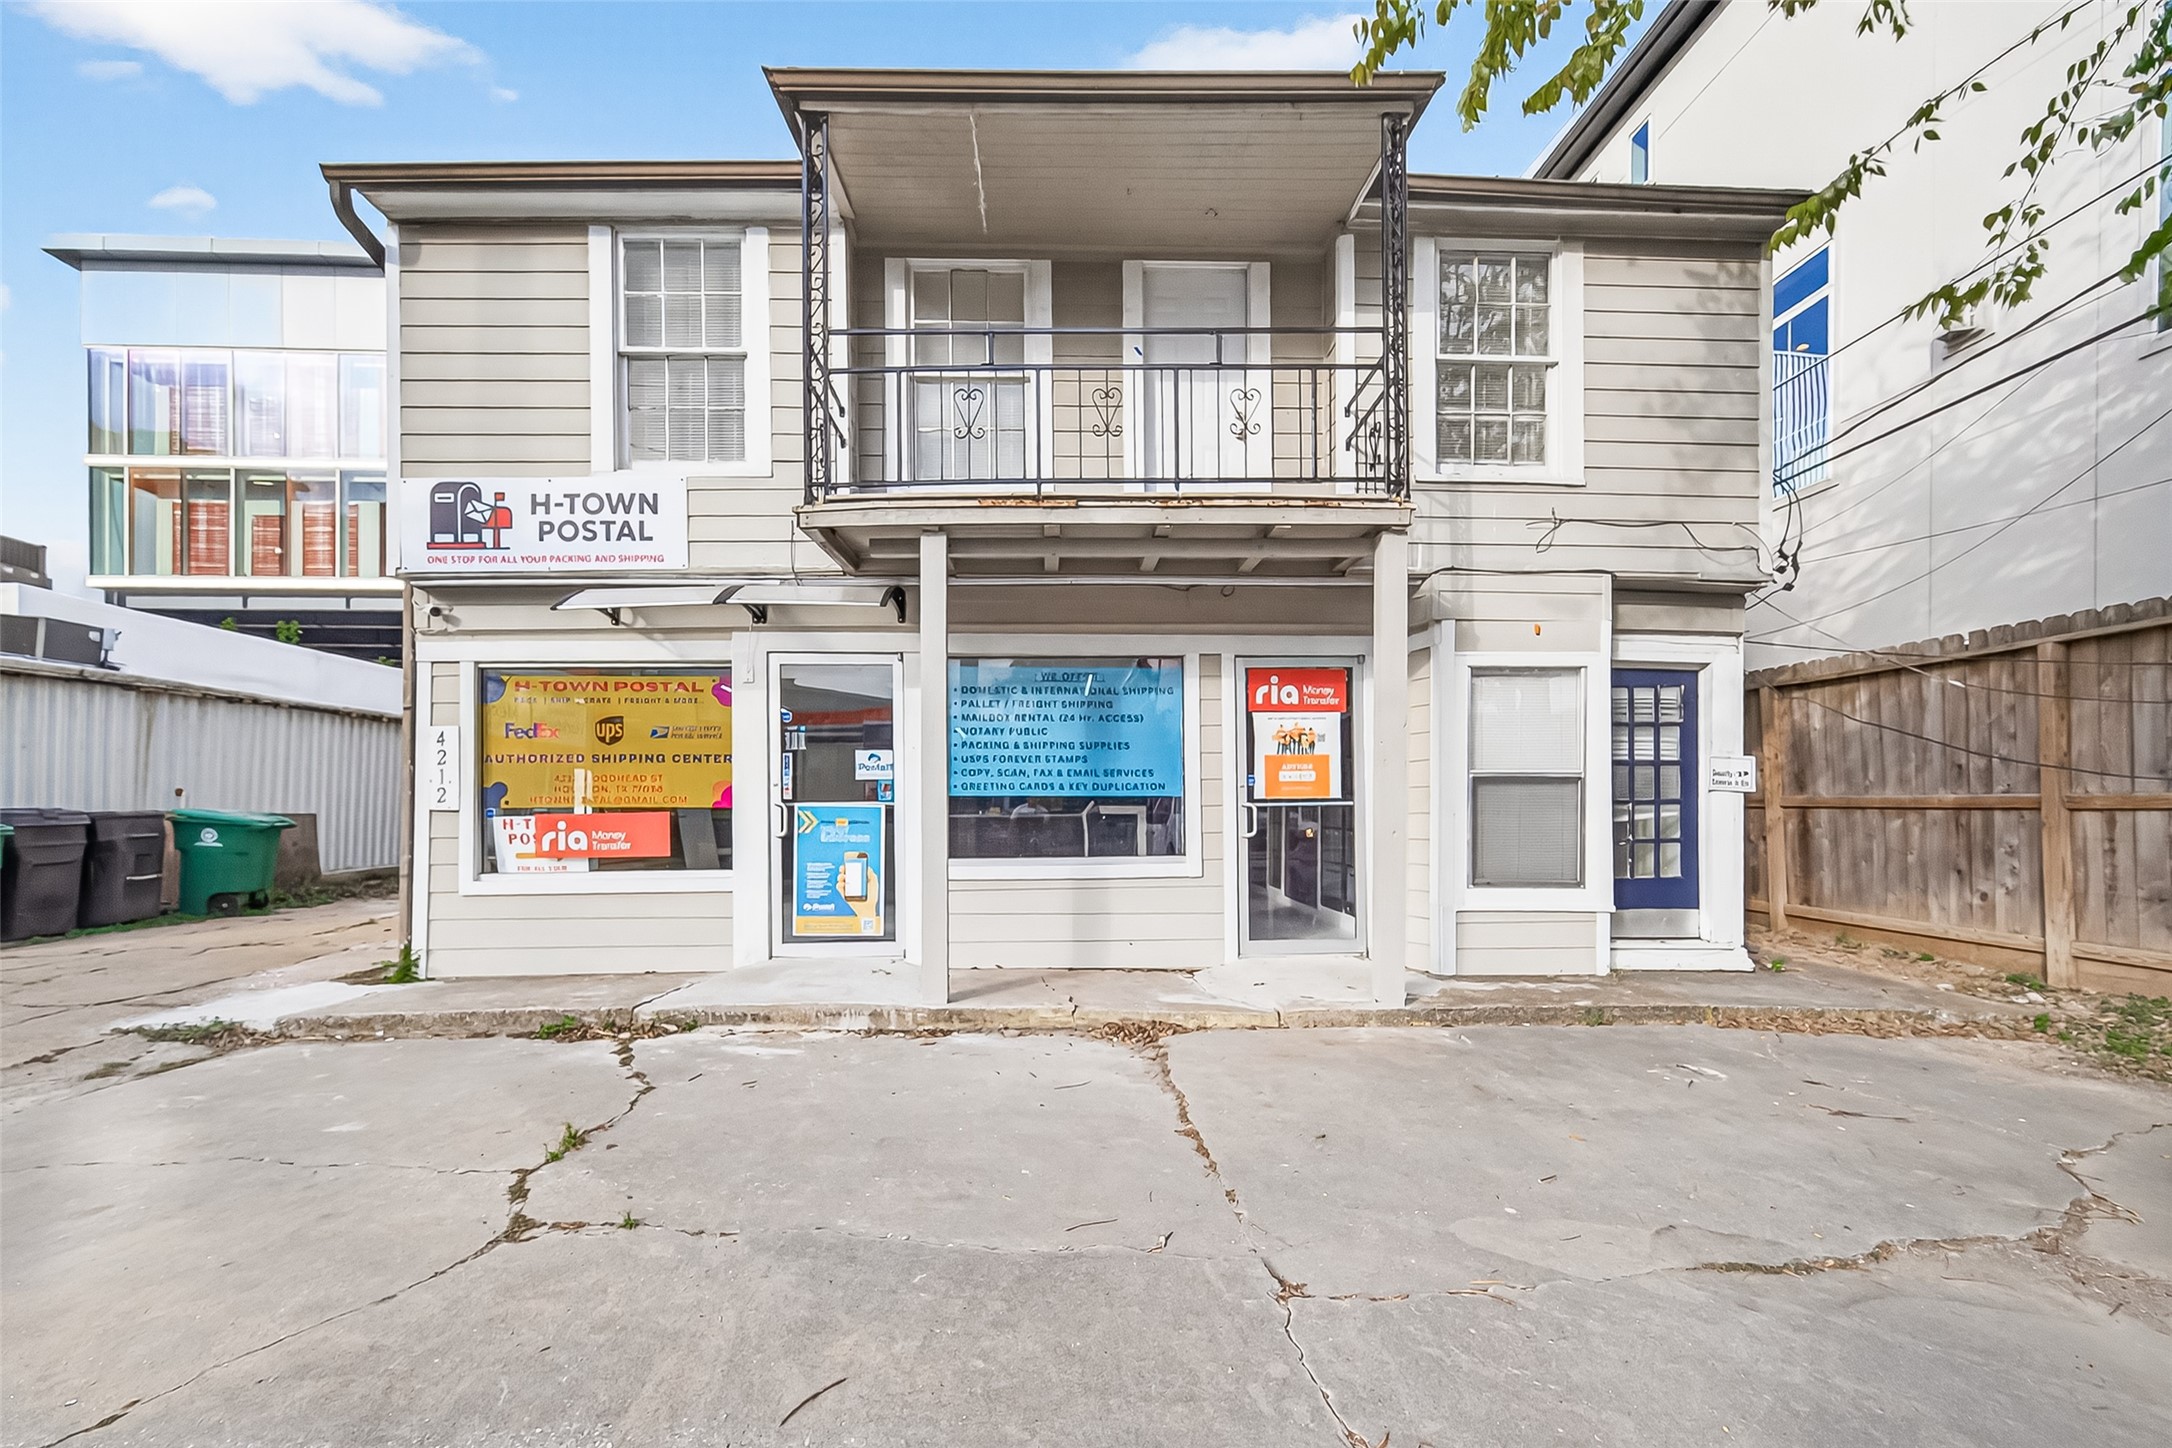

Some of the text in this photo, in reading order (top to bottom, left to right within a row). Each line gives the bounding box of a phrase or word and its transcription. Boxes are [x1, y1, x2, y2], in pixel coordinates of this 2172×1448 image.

[530, 492, 659, 515] H-TOWN
[538, 520, 654, 542] POSTAL
[427, 554, 665, 564] ONE STOP FOR ALL YOUR PACKING AND SHIPPING
[514, 680, 704, 692] H-TOWN POSTAL
[960, 686, 1019, 695] DOMESTIC
[1021, 686, 1028, 695] &
[1122, 687, 1174, 695] SHIPPING
[1255, 675, 1299, 705] ria
[1302, 685, 1335, 696] Money
[961, 700, 1001, 708] PALLET
[1012, 700, 1058, 708] FREIGHT
[1061, 701, 1114, 709] SHIPPING
[1303, 695, 1340, 705] Transfer
[961, 714, 1011, 722] MAILBOX
[1014, 714, 1055, 722] RENTAL
[1098, 714, 1144, 723] ACCESS)
[505, 722, 560, 739] FedEx
[962, 727, 1049, 736] NOTARY PUBLIC
[961, 741, 1131, 750] PACKING & SHIPPING SUPPLIES
[485, 754, 732, 764] AUTHORIZED SHIPPING CENTER
[961, 755, 1089, 764] USPS FOREVER STAMPS
[436, 730, 448, 804] 4212
[997, 769, 1030, 778] SCAN,
[1034, 769, 1053, 777] FAX
[1057, 769, 1063, 777] &
[1067, 769, 1100, 777] EMAIL
[1103, 769, 1155, 777] SERVICES
[961, 782, 1166, 791] GREETING CARDS & KEY DUPLICATION
[541, 820, 589, 852] ria
[591, 830, 627, 841] Money
[592, 840, 632, 851] Transfer
